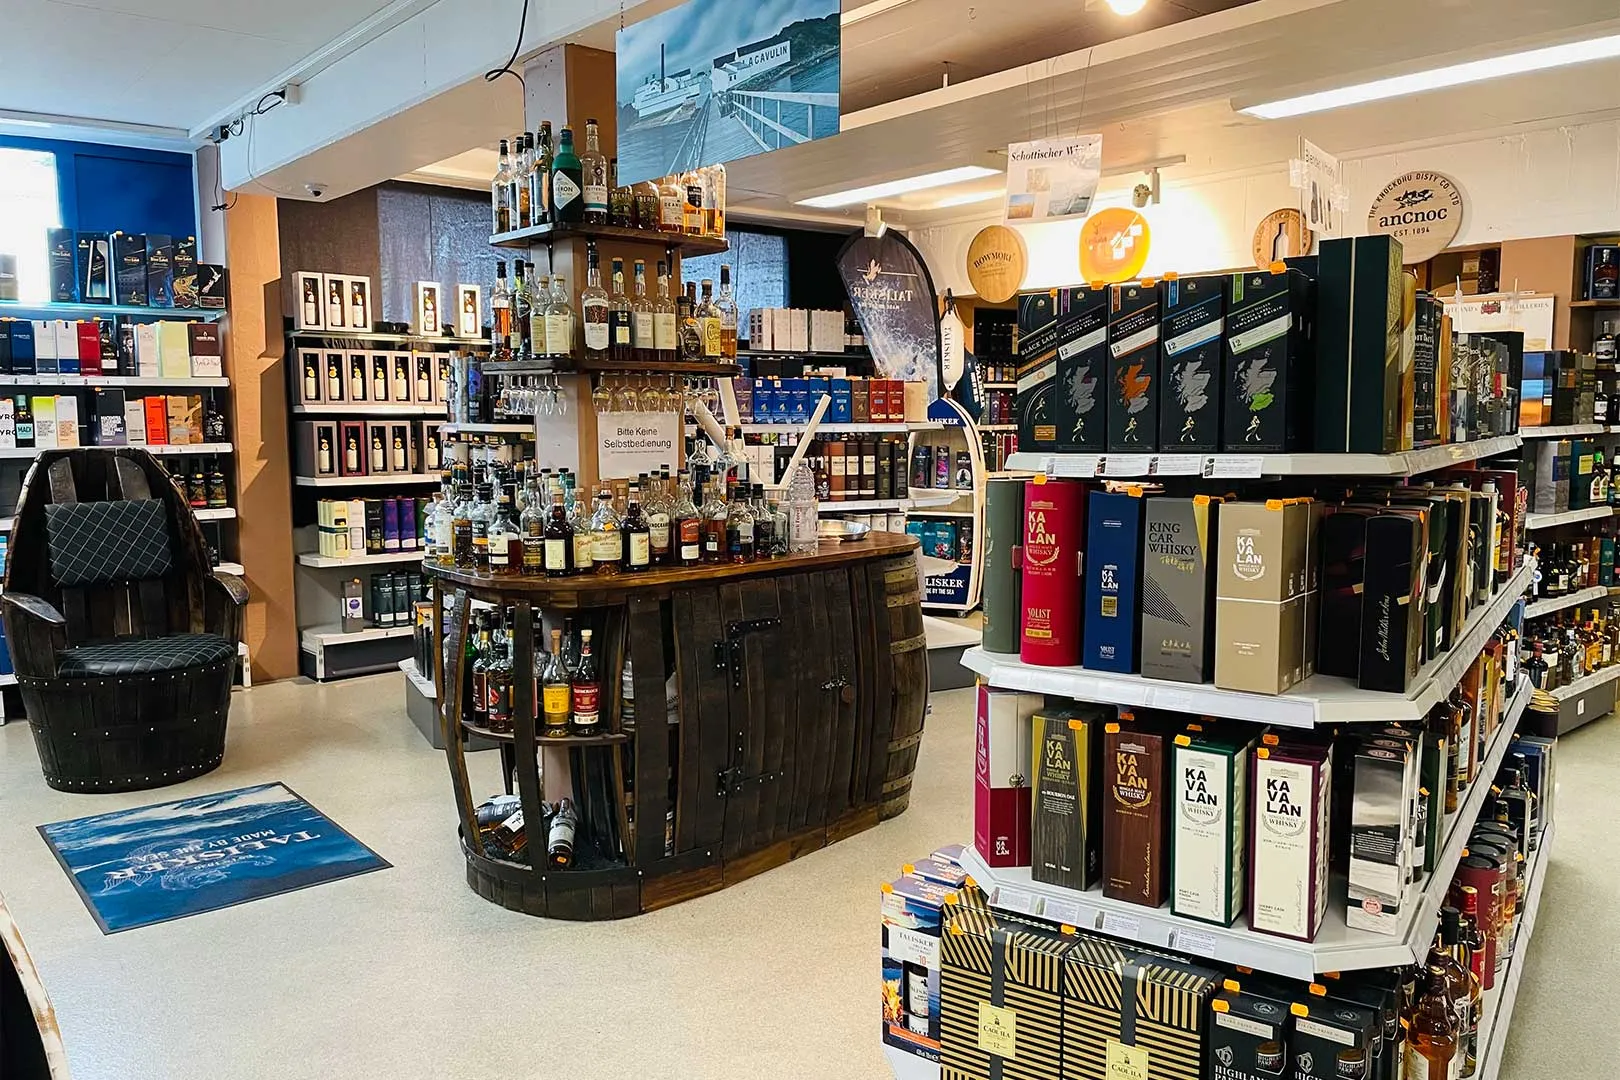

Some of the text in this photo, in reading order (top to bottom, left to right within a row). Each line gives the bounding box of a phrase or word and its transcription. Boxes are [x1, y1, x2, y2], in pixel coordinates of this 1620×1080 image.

[1011, 147, 1063, 162] Schottischer
[1368, 204, 1378, 219] THE
[1416, 173, 1438, 182] DISTY
[1448, 191, 1460, 206] LTD
[1379, 208, 1448, 228] anCnoc
[1393, 228, 1408, 238] EST
[974, 251, 1013, 269] BOWMORE
[943, 327, 952, 370] TALISKER
[1021, 331, 1057, 356] BLACK LABE
[617, 427, 658, 436] Bitte Keine
[604, 439, 672, 449] Selbstbedienung
[1028, 511, 1046, 523] KA
[1028, 523, 1046, 533] VA
[1149, 522, 1181, 534] KING
[1028, 533, 1056, 545] LAN
[1149, 533, 1174, 543] CAR
[1236, 536, 1254, 547] KA
[1149, 543, 1197, 556] WHISKY
[1236, 546, 1254, 555] VA
[1236, 554, 1262, 564] LAN
[1102, 569, 1113, 577] KA
[926, 578, 964, 589] LISKER
[1101, 582, 1118, 590] LAN
[1027, 608, 1051, 619] SOLIST
[1046, 740, 1063, 751] KA
[1046, 750, 1063, 760] VA
[1116, 753, 1138, 766] KA
[1046, 759, 1071, 770] LAN
[1117, 765, 1138, 776] VA
[1185, 768, 1207, 782] KA
[1117, 775, 1148, 790] LAN
[1186, 780, 1207, 793] VA
[1267, 778, 1290, 793] KA
[1119, 790, 1145, 800] WHISKY
[1185, 790, 1218, 806] LAN
[1267, 791, 1290, 804] VA
[1187, 807, 1214, 817] WHISKY
[1266, 801, 1302, 817] LAN
[1269, 819, 1297, 828] WHISKY
[135, 829, 275, 863] MADE BY THE SEA
[104, 831, 321, 880] TALISKER
[899, 932, 934, 948] TALISKER
[983, 1025, 1011, 1039] CAOL ILA
[1111, 1063, 1142, 1080] CAOL ILA
